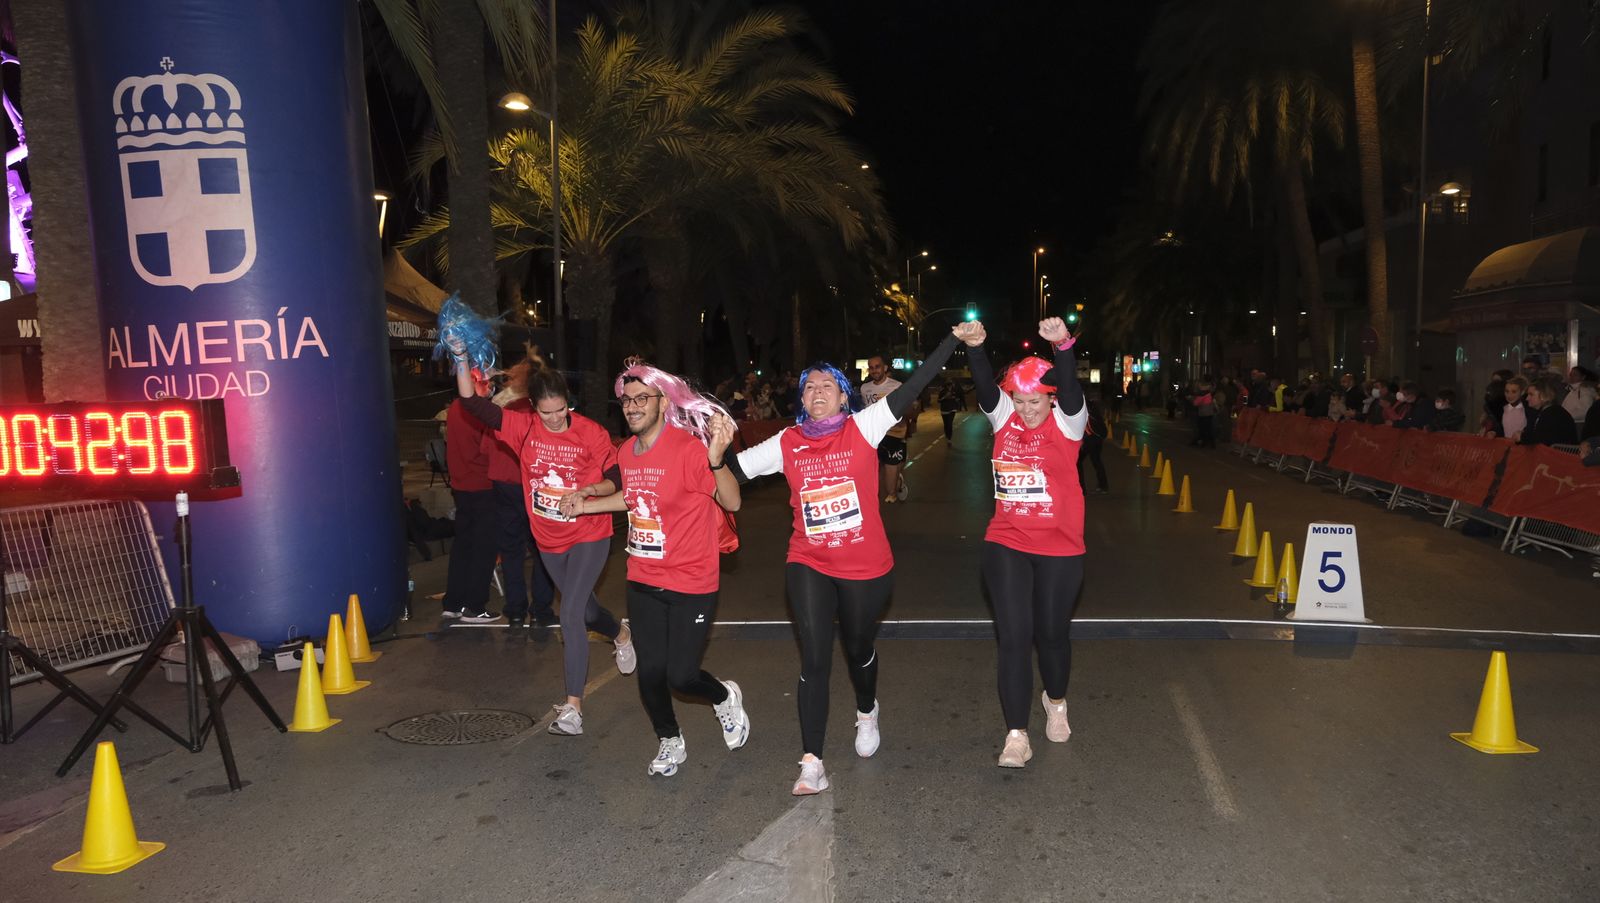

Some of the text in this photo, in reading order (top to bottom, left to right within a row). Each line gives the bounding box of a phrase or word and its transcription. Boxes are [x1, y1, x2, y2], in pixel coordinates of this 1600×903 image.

[108, 306, 329, 369] ALMERÍA
[143, 370, 271, 400] CIUDAD
[1000, 474, 1036, 486] 3273
[812, 498, 850, 517] 3169
[631, 530, 655, 543] 355
[1312, 526, 1353, 535] MONDO
[1317, 551, 1346, 593] 5
